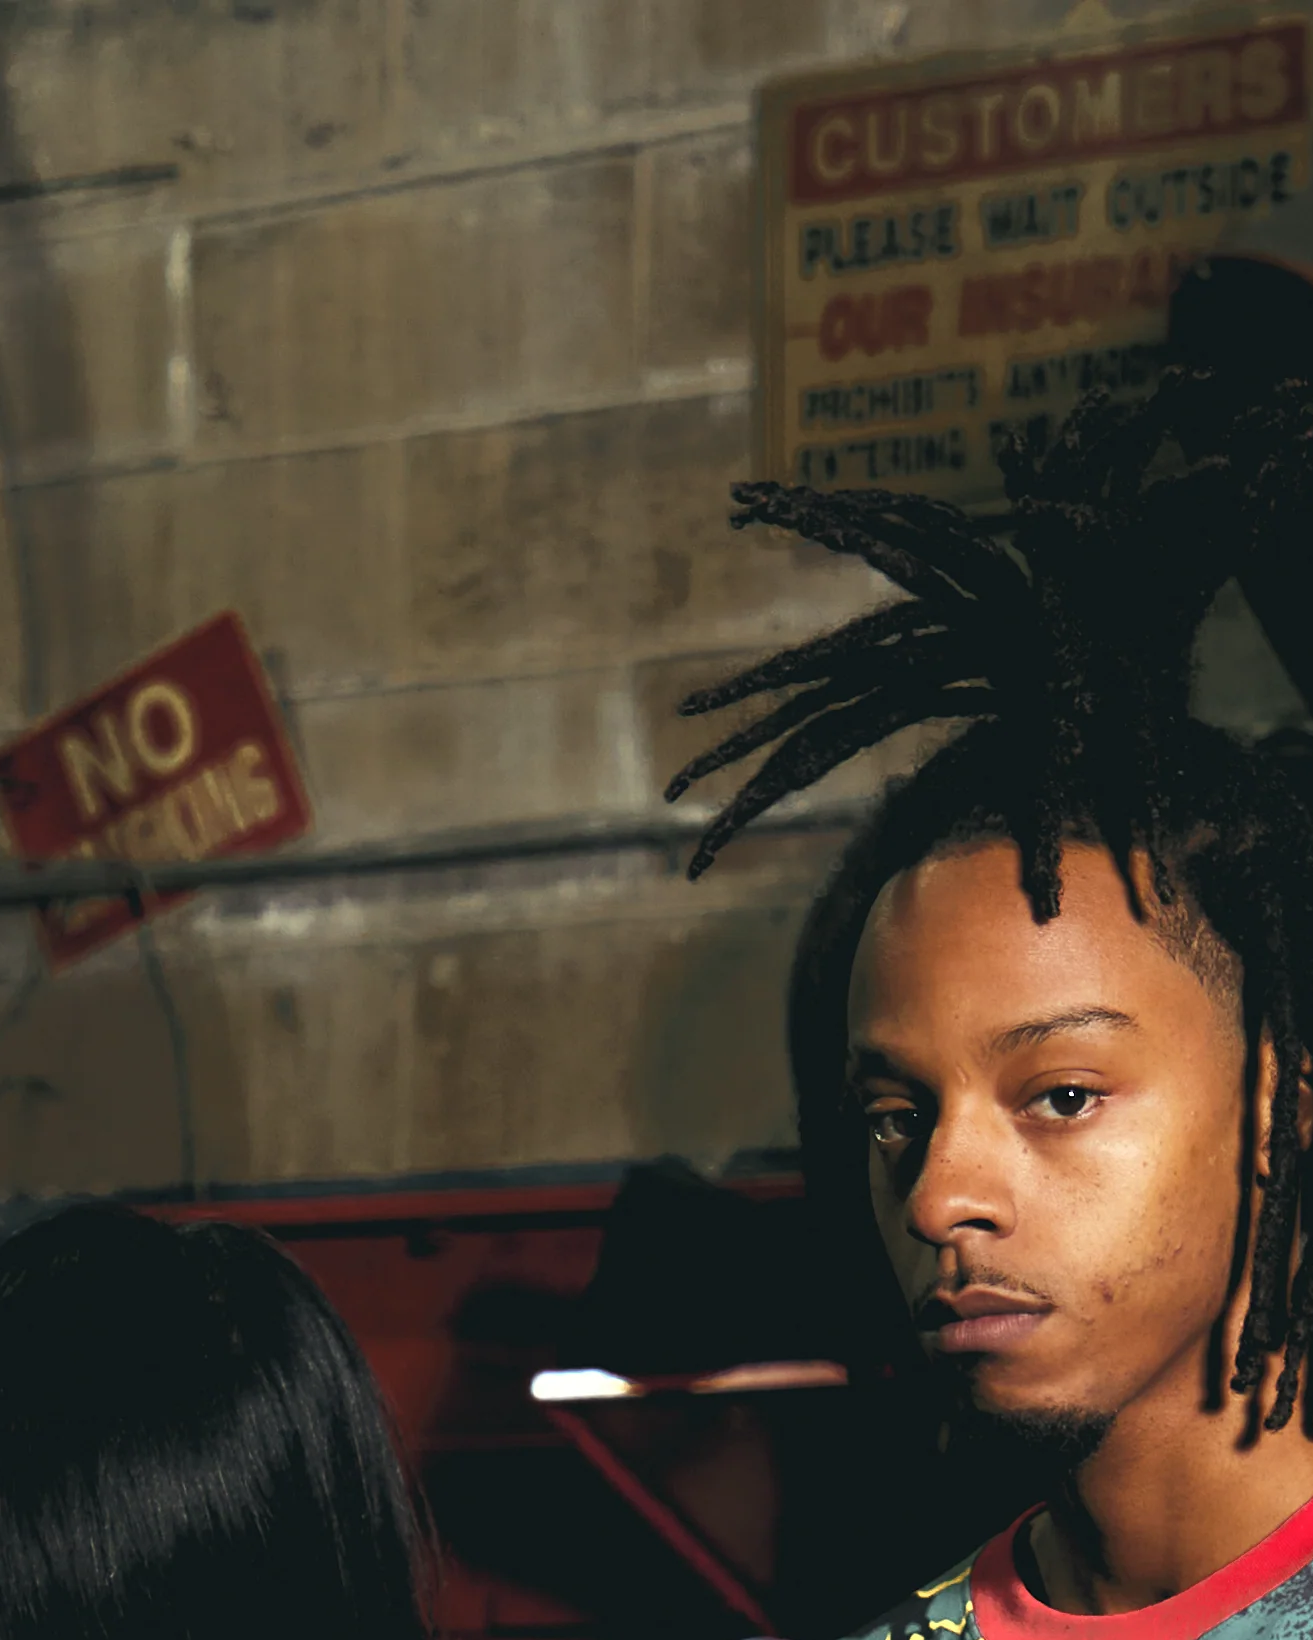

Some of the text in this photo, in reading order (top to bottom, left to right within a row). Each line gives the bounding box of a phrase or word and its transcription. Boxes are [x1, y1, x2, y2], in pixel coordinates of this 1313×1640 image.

[810, 36, 1288, 182] CUSTOMERS
[801, 151, 1293, 280] PLEASE WAIT OUTSIDE
[818, 285, 934, 362] OUR
[58, 678, 196, 816] NO
